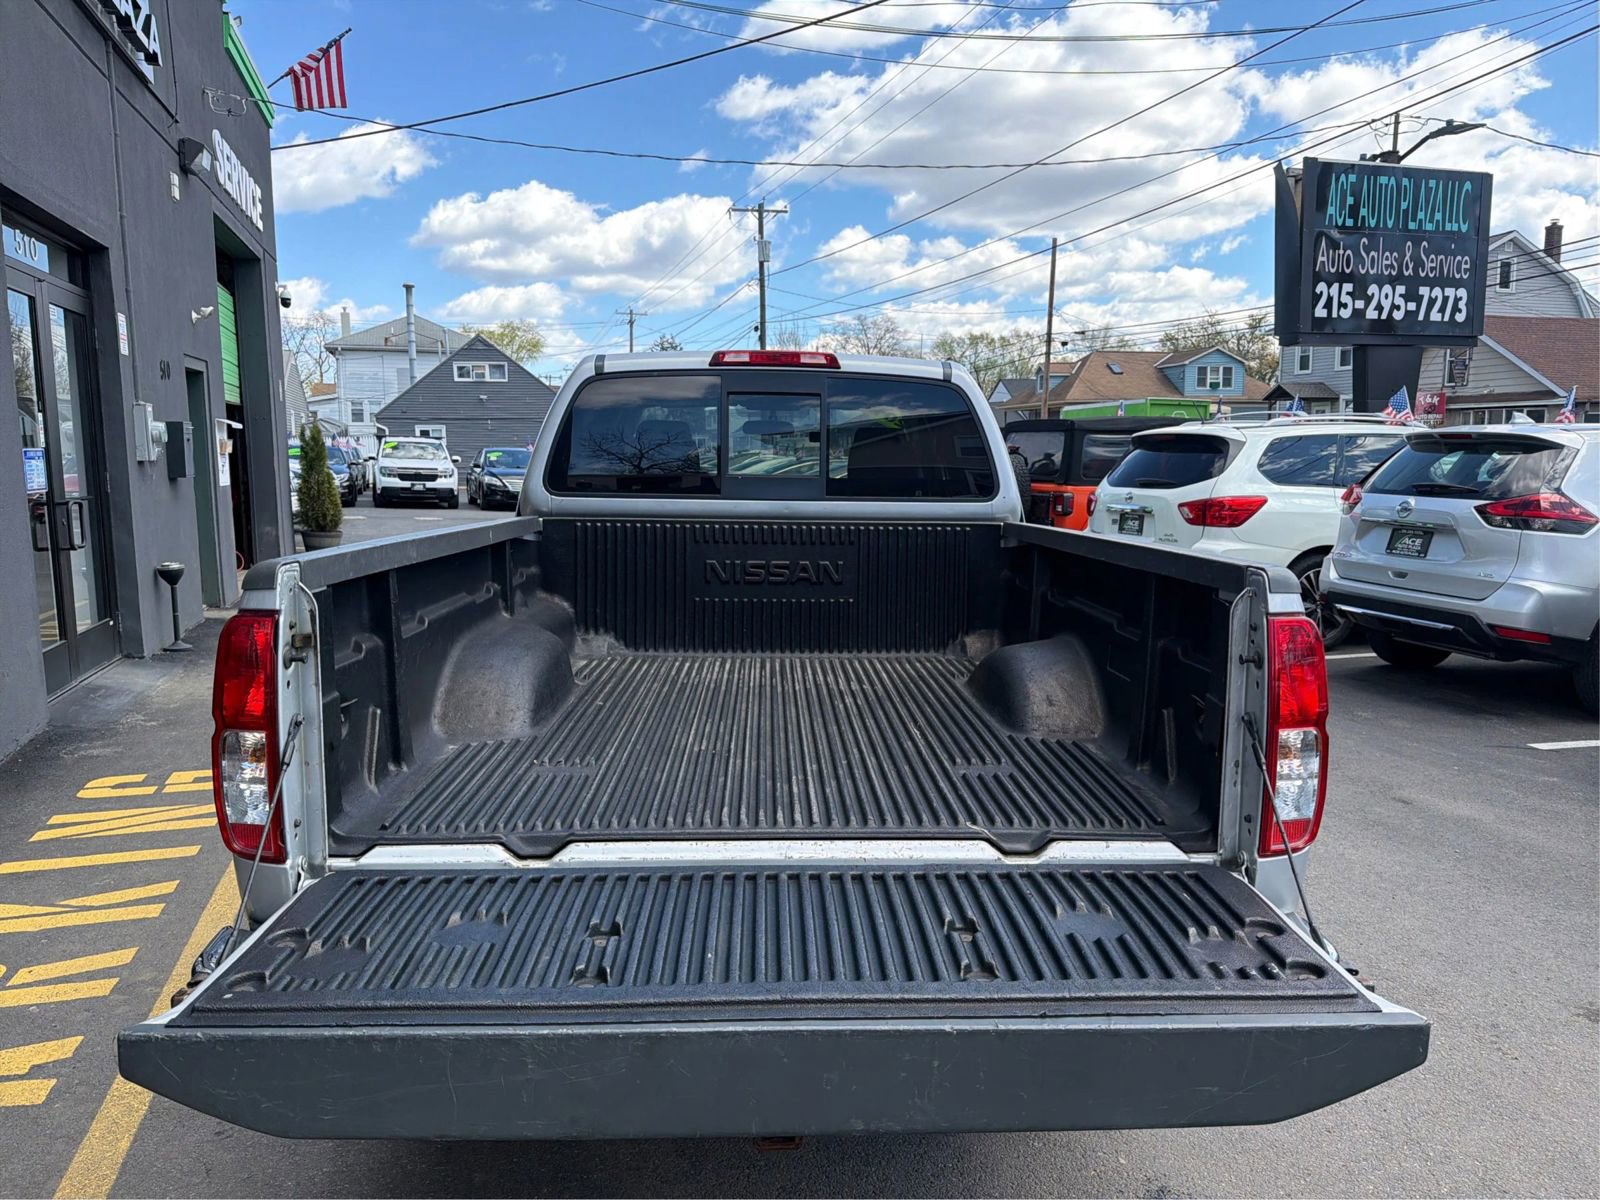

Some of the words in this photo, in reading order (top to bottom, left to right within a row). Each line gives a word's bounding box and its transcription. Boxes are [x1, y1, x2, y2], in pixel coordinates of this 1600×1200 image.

[212, 129, 264, 232] SERVICE
[1325, 172, 1357, 227] ACE
[1357, 175, 1397, 229] AUTO
[1399, 177, 1443, 231] PLAZA
[1444, 180, 1473, 232] LLC
[14, 229, 38, 262] 510
[1315, 235, 1354, 275] Auto
[1358, 237, 1398, 274] Sales
[1403, 240, 1414, 275] &
[1419, 240, 1471, 280] Service
[1314, 281, 1468, 323] 215-295-7273
[159, 360, 171, 380] 510
[1401, 537, 1423, 546] ACE
[704, 559, 844, 585] NISSAN
